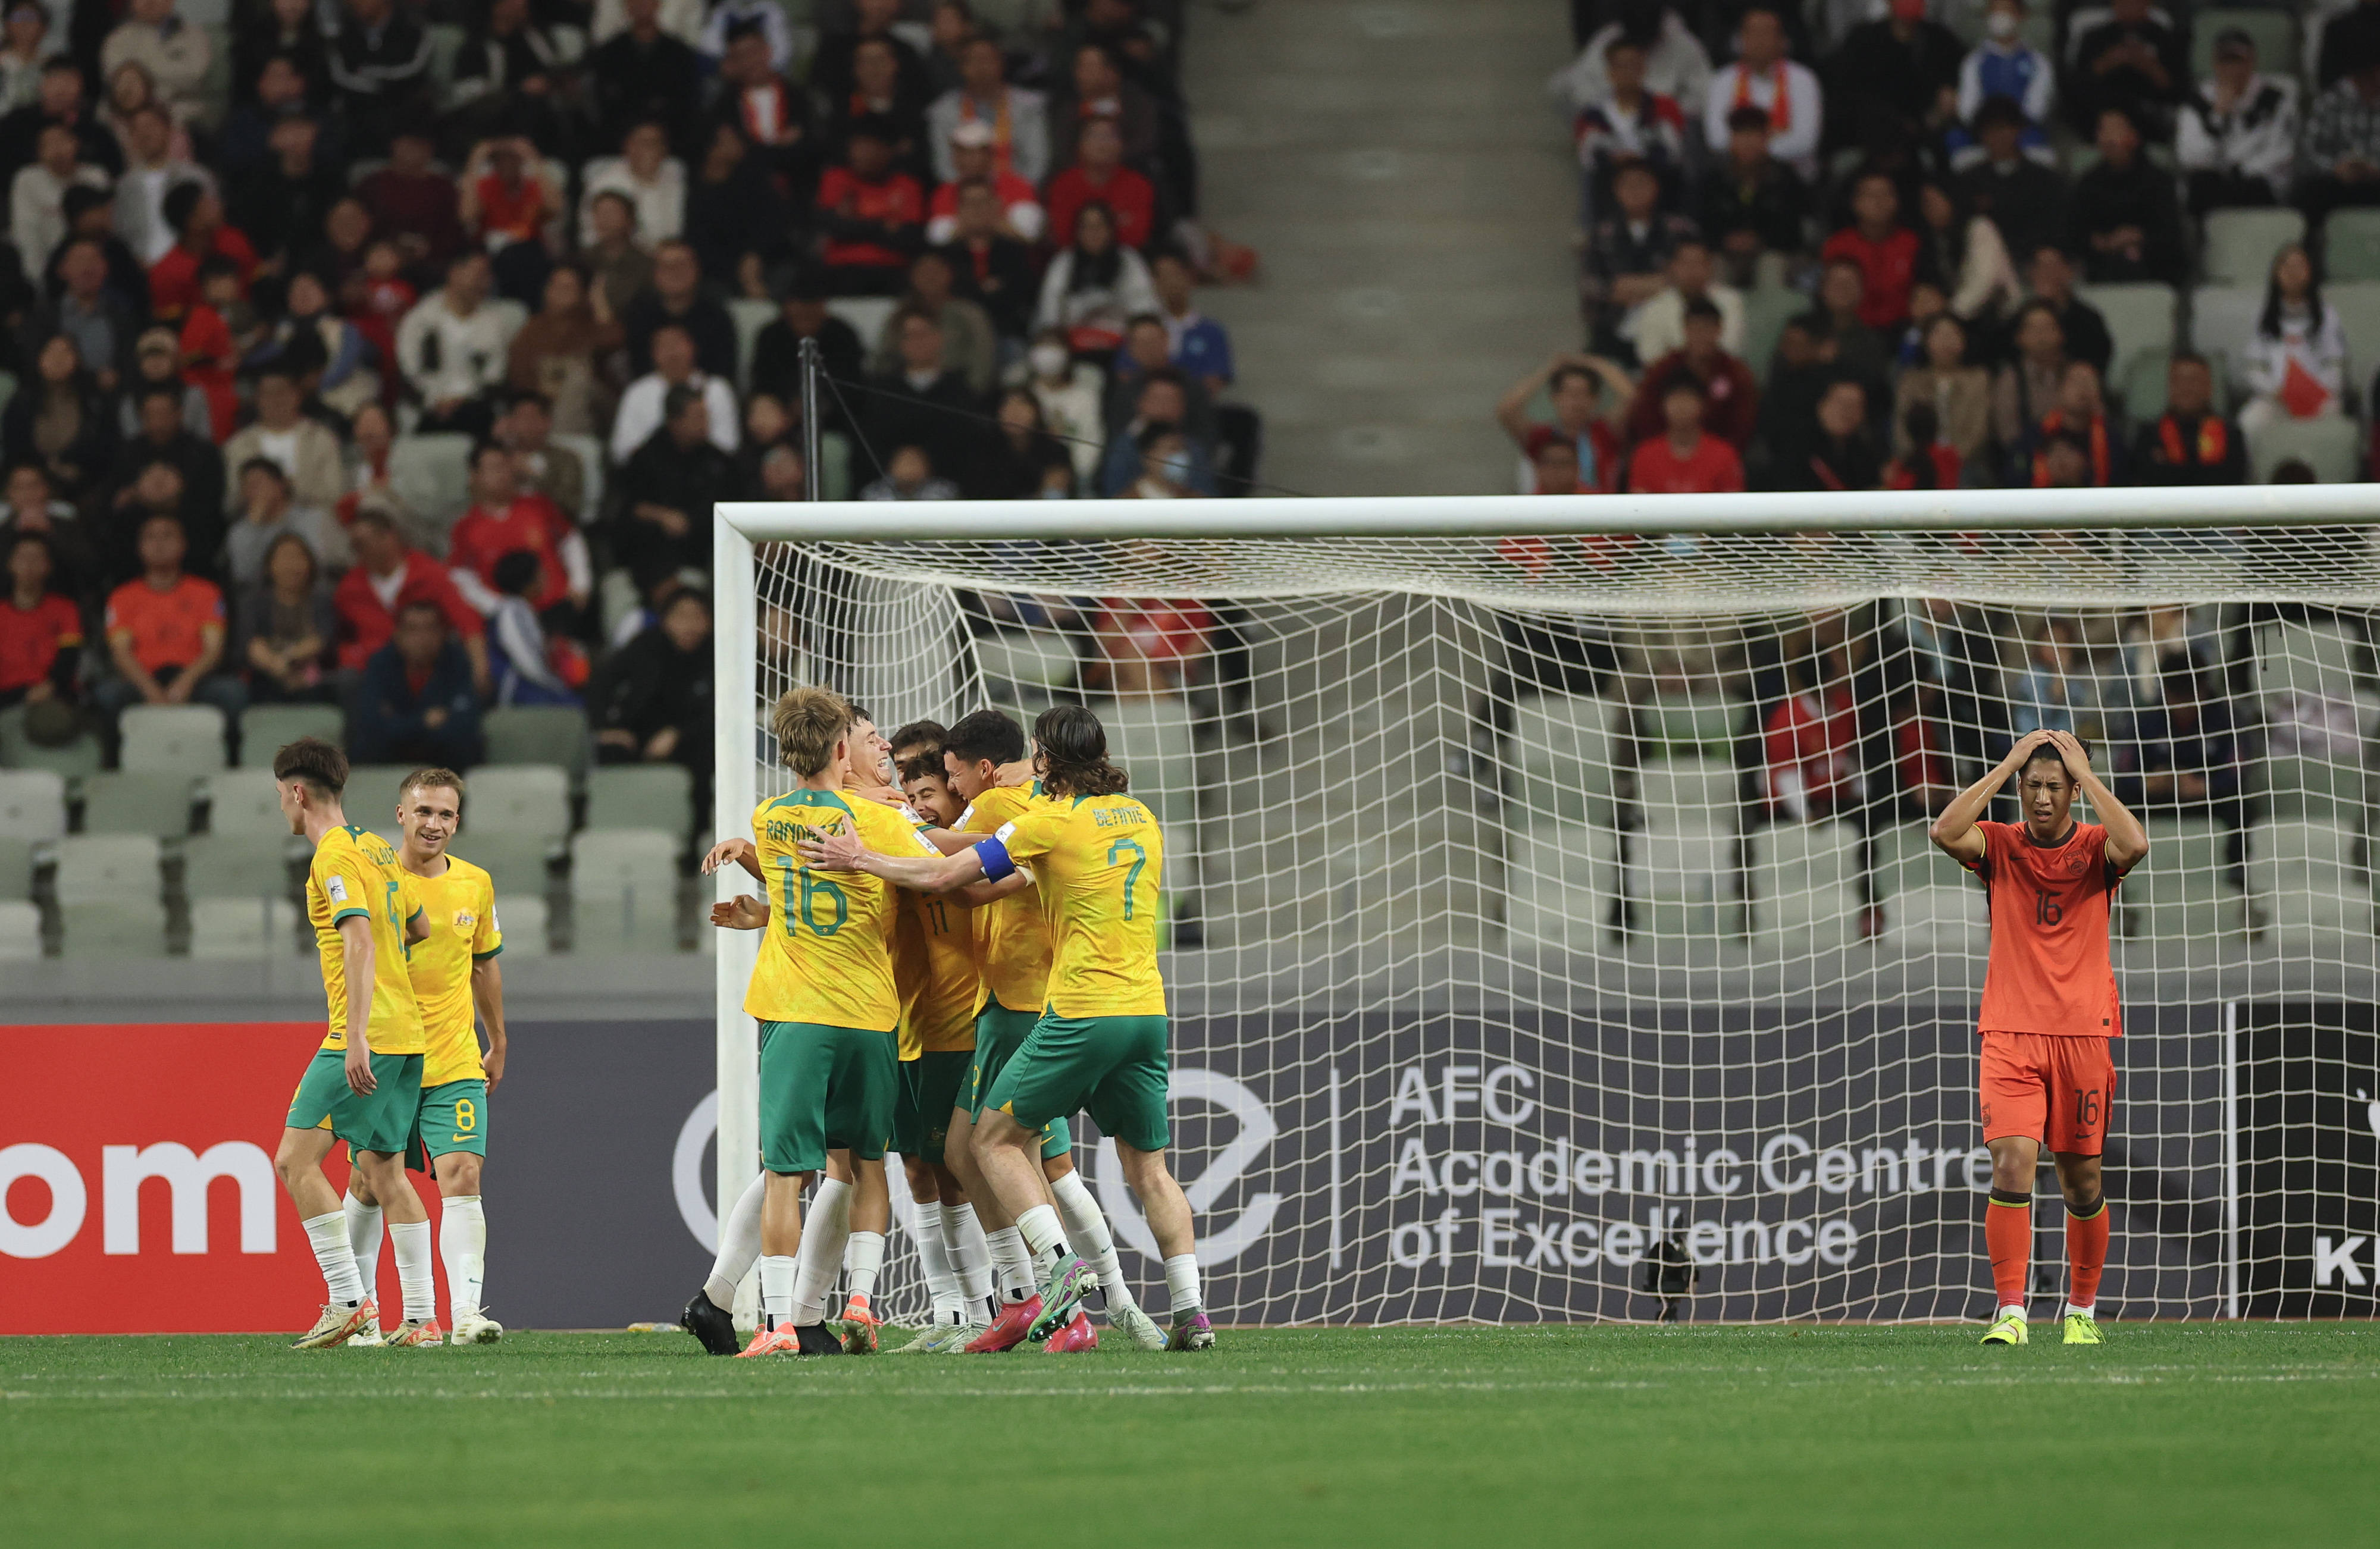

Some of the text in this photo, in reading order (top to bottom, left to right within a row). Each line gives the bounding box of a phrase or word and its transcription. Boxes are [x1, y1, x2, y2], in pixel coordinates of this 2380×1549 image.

[776, 855, 848, 936] 16
[1108, 839, 1145, 920] 7
[2035, 890, 2062, 926] 16
[926, 900, 949, 936] 11
[455, 1098, 477, 1131] 8
[1389, 1065, 1536, 1125] AFC
[2075, 1089, 2099, 1125] 16
[1389, 1134, 1992, 1196] Academic Centre
[0, 1140, 277, 1259] om
[1391, 1208, 1859, 1269] of Excellence
